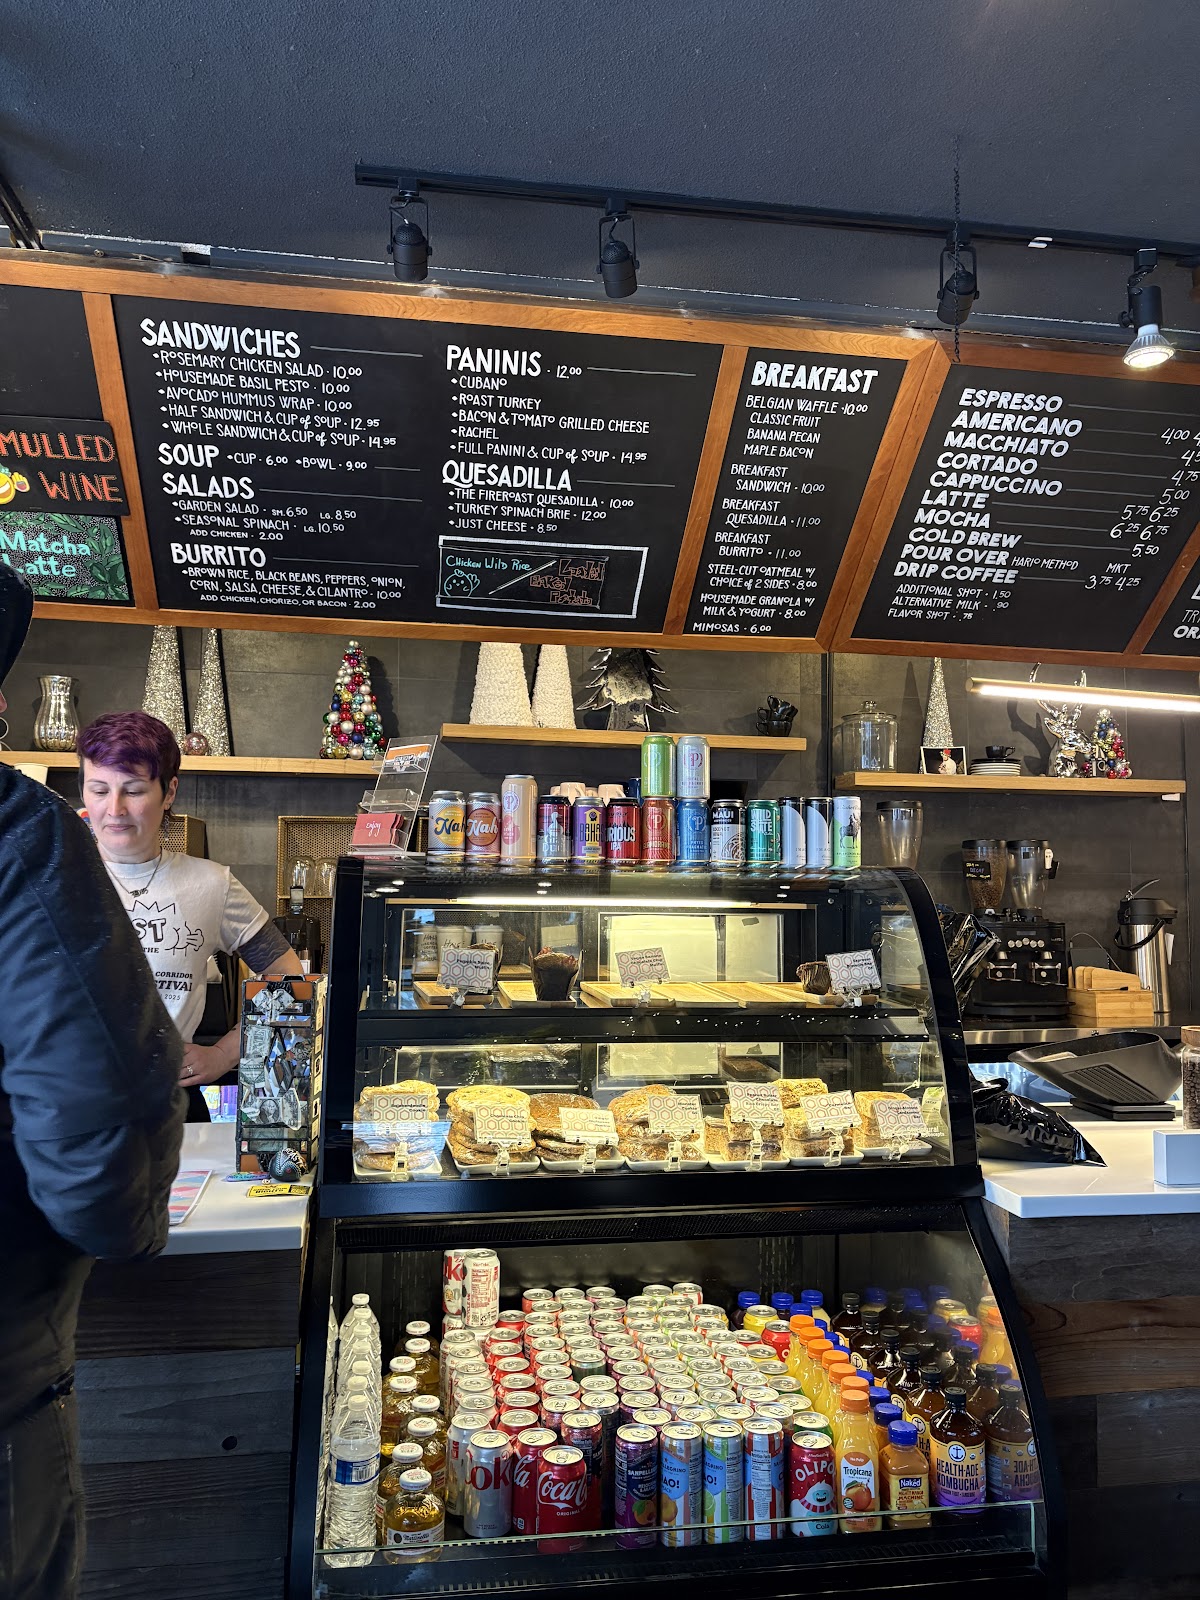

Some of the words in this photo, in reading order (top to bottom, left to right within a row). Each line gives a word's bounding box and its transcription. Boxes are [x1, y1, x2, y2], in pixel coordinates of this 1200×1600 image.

[140, 318, 300, 358] SANDWICHES
[160, 350, 226, 369] ROSEMARY
[230, 357, 282, 374] CHICKEN
[285, 361, 324, 377] SALAD
[333, 366, 362, 379] 10.00
[447, 345, 542, 377] PANINIS
[556, 365, 582, 379] 12.00
[163, 369, 236, 387] HOUSEMADE
[239, 375, 273, 390] BASIL
[275, 378, 310, 392] PESTO
[322, 382, 350, 394] 10.00
[459, 375, 507, 390] CUBANO
[751, 361, 878, 394] BREAKFAST
[167, 386, 219, 402] AVOCADO
[221, 391, 275, 407] HUMMUS
[279, 396, 314, 410] WRAP
[325, 400, 352, 412] 10.00
[459, 393, 495, 407] ROAST
[497, 396, 541, 410] TURKEY
[745, 395, 794, 410] BELGIAN
[797, 399, 839, 413] WAFFLE
[843, 403, 868, 415] 10.00
[959, 388, 1063, 413] ESPRESSO
[459, 409, 496, 423] BACON
[498, 412, 510, 425] &
[511, 413, 555, 427] TOMATO
[559, 416, 605, 431] GRILLED
[608, 419, 649, 433] CHEESE
[750, 412, 792, 425] CLASSIC
[792, 415, 821, 427] FRUIT
[951, 410, 1082, 437] AMERICANO
[1161, 428, 1190, 445] 4.00
[458, 426, 499, 439] RACHEL
[747, 428, 786, 441] BANANA
[789, 431, 821, 443] PECAN
[0, 430, 115, 462] MULLED
[458, 442, 484, 454] FULL
[487, 443, 525, 457] PANINI
[527, 446, 538, 459] &
[541, 447, 564, 459] CUP
[565, 449, 578, 464] of
[581, 449, 610, 462] SOUP
[621, 452, 647, 464] 14.95
[743, 444, 777, 456] MAPLE
[779, 446, 814, 459] BACON
[943, 431, 1069, 457] MACCHIATO
[158, 443, 219, 468] SOUP
[234, 452, 256, 464] CUP
[266, 455, 288, 466] 6.00
[303, 457, 336, 470] BOWL
[346, 461, 367, 471] 9.00
[442, 460, 572, 491] QUESADILLA
[731, 464, 788, 477] BREAKFAST
[937, 452, 1038, 475] CORTADO
[1171, 470, 1200, 486] 4.75
[38, 471, 122, 502] WINE
[162, 472, 254, 499] SALADS
[736, 479, 791, 493] SANDWICH
[801, 483, 825, 494] 10.00
[930, 471, 1062, 496] CAPPUCCINO
[1159, 489, 1190, 505] 5.00
[454, 488, 476, 500] THE
[479, 489, 534, 503] FIREROAST
[537, 494, 598, 507] QUESADILLA
[610, 499, 634, 509] 10.00
[722, 498, 781, 512] BREAKFAST
[921, 489, 989, 509] LATTE
[1121, 505, 1150, 520] 5.75
[1149, 507, 1180, 522] 6.25
[182, 514, 239, 527] SEASONAL
[243, 518, 289, 530] SPINACH
[318, 523, 344, 533] 10.50
[455, 518, 483, 529] JUST
[486, 520, 527, 532] CHEESE
[537, 523, 557, 533] 8.50
[725, 513, 786, 528] QUESADILLA
[796, 517, 821, 527] 11.00
[914, 508, 990, 528] MOCHA
[1110, 523, 1141, 538] 6.25
[1140, 525, 1170, 540] 6.75
[0, 530, 90, 556] Matcha
[210, 530, 248, 538] CHICKEN
[259, 532, 283, 540] 2.00
[715, 532, 771, 544] BREAKFAST
[909, 527, 966, 544] COLD
[967, 531, 1022, 548] BREW
[1132, 544, 1159, 557] 5.50
[170, 543, 266, 567] BURRITO
[719, 545, 763, 557] BURRITO
[776, 549, 801, 559] 11.00
[901, 544, 953, 561] POUR
[956, 548, 1009, 565] OVER
[1011, 556, 1041, 567] HARIO
[1040, 559, 1079, 570] METHOD
[1106, 563, 1131, 574] MKT
[188, 567, 225, 578] BROWN
[227, 569, 253, 581] RICE,
[255, 570, 287, 581] BLACK
[289, 572, 323, 584] BEANS,
[325, 574, 369, 587] PEPPERS,
[371, 577, 405, 589] ONION,
[894, 561, 939, 578] DRIP
[941, 565, 1019, 583] COFFEE
[1085, 575, 1113, 589] 3.75
[1115, 577, 1141, 591] 4.25
[190, 580, 222, 592] CORN,
[225, 581, 261, 595] SALSA,
[262, 583, 305, 597] CHEESE,
[306, 585, 316, 596] &
[317, 584, 369, 598] CILANTRO
[377, 591, 401, 599] 10.00
[896, 584, 952, 596] ADDITIONAL
[957, 588, 983, 598] SHOT
[993, 590, 1011, 599] 1.50
[892, 596, 953, 608] ALTERNATIVE
[956, 600, 981, 610] MILK
[888, 608, 923, 618] FLAVOR
[926, 610, 950, 620] SHOT
[693, 622, 739, 632] MIMOSAS
[750, 624, 771, 633] 6.00
[712, 810, 734, 819] MAUI
[466, 816, 499, 837] Nah
[842, 1466, 872, 1478] Tropicana
[936, 1471, 980, 1491] KOMBUCHA
[900, 1479, 921, 1487] Naked
